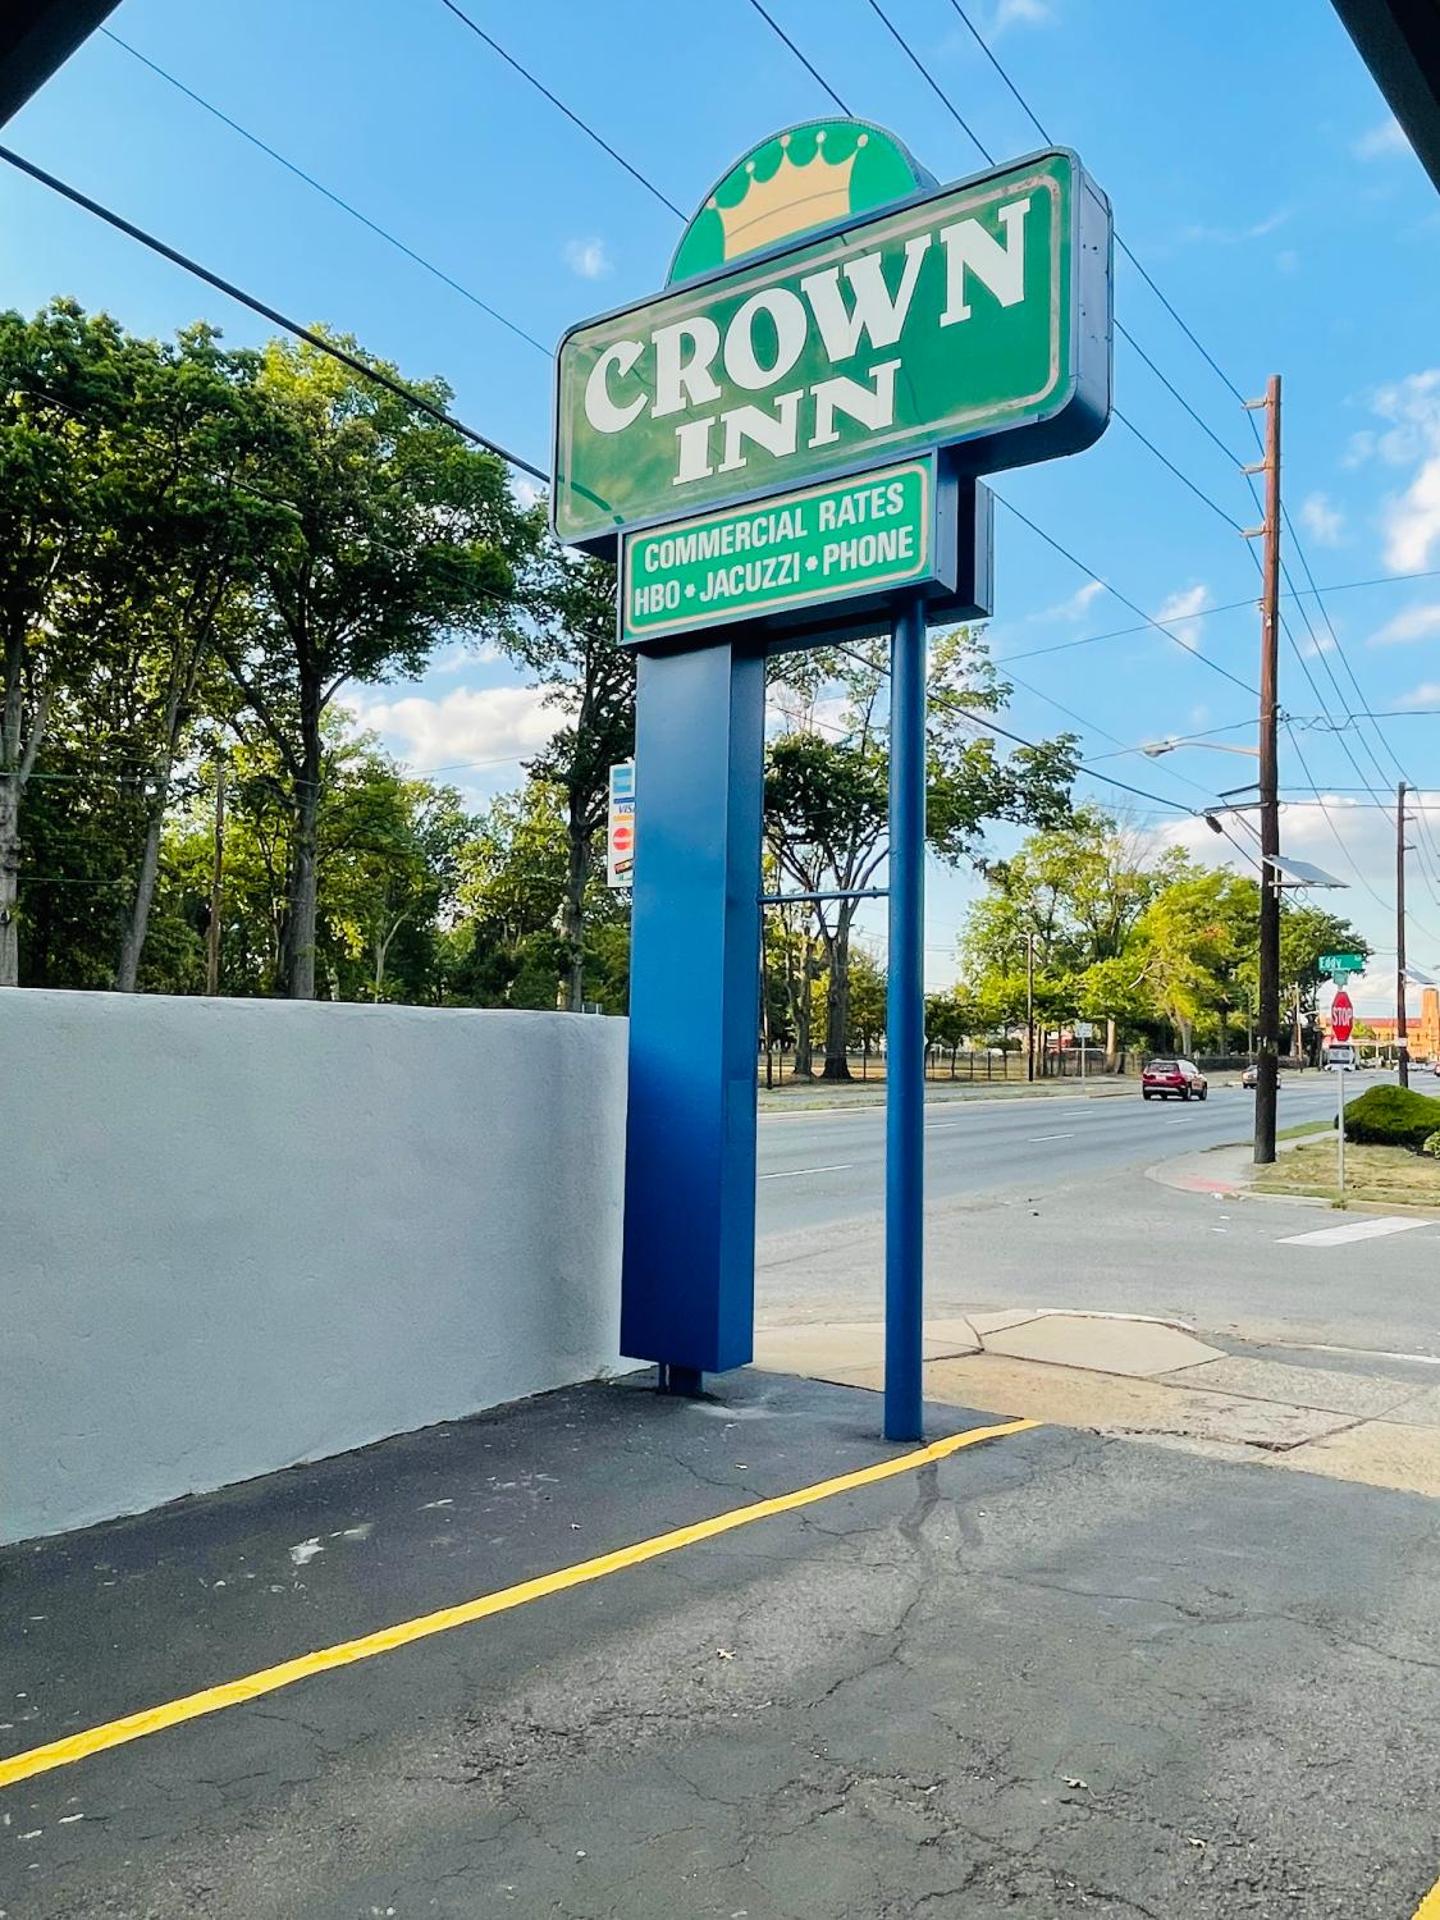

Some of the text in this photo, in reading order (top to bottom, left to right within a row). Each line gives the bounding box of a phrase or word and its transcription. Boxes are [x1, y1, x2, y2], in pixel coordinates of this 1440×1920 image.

[584, 198, 1031, 434] CROWN
[672, 358, 902, 487] INN
[633, 524, 914, 617] HBO JACUZZI PHONE
[643, 482, 905, 573] COMMERCIAL RATES
[1333, 1007, 1353, 1026] STOP
